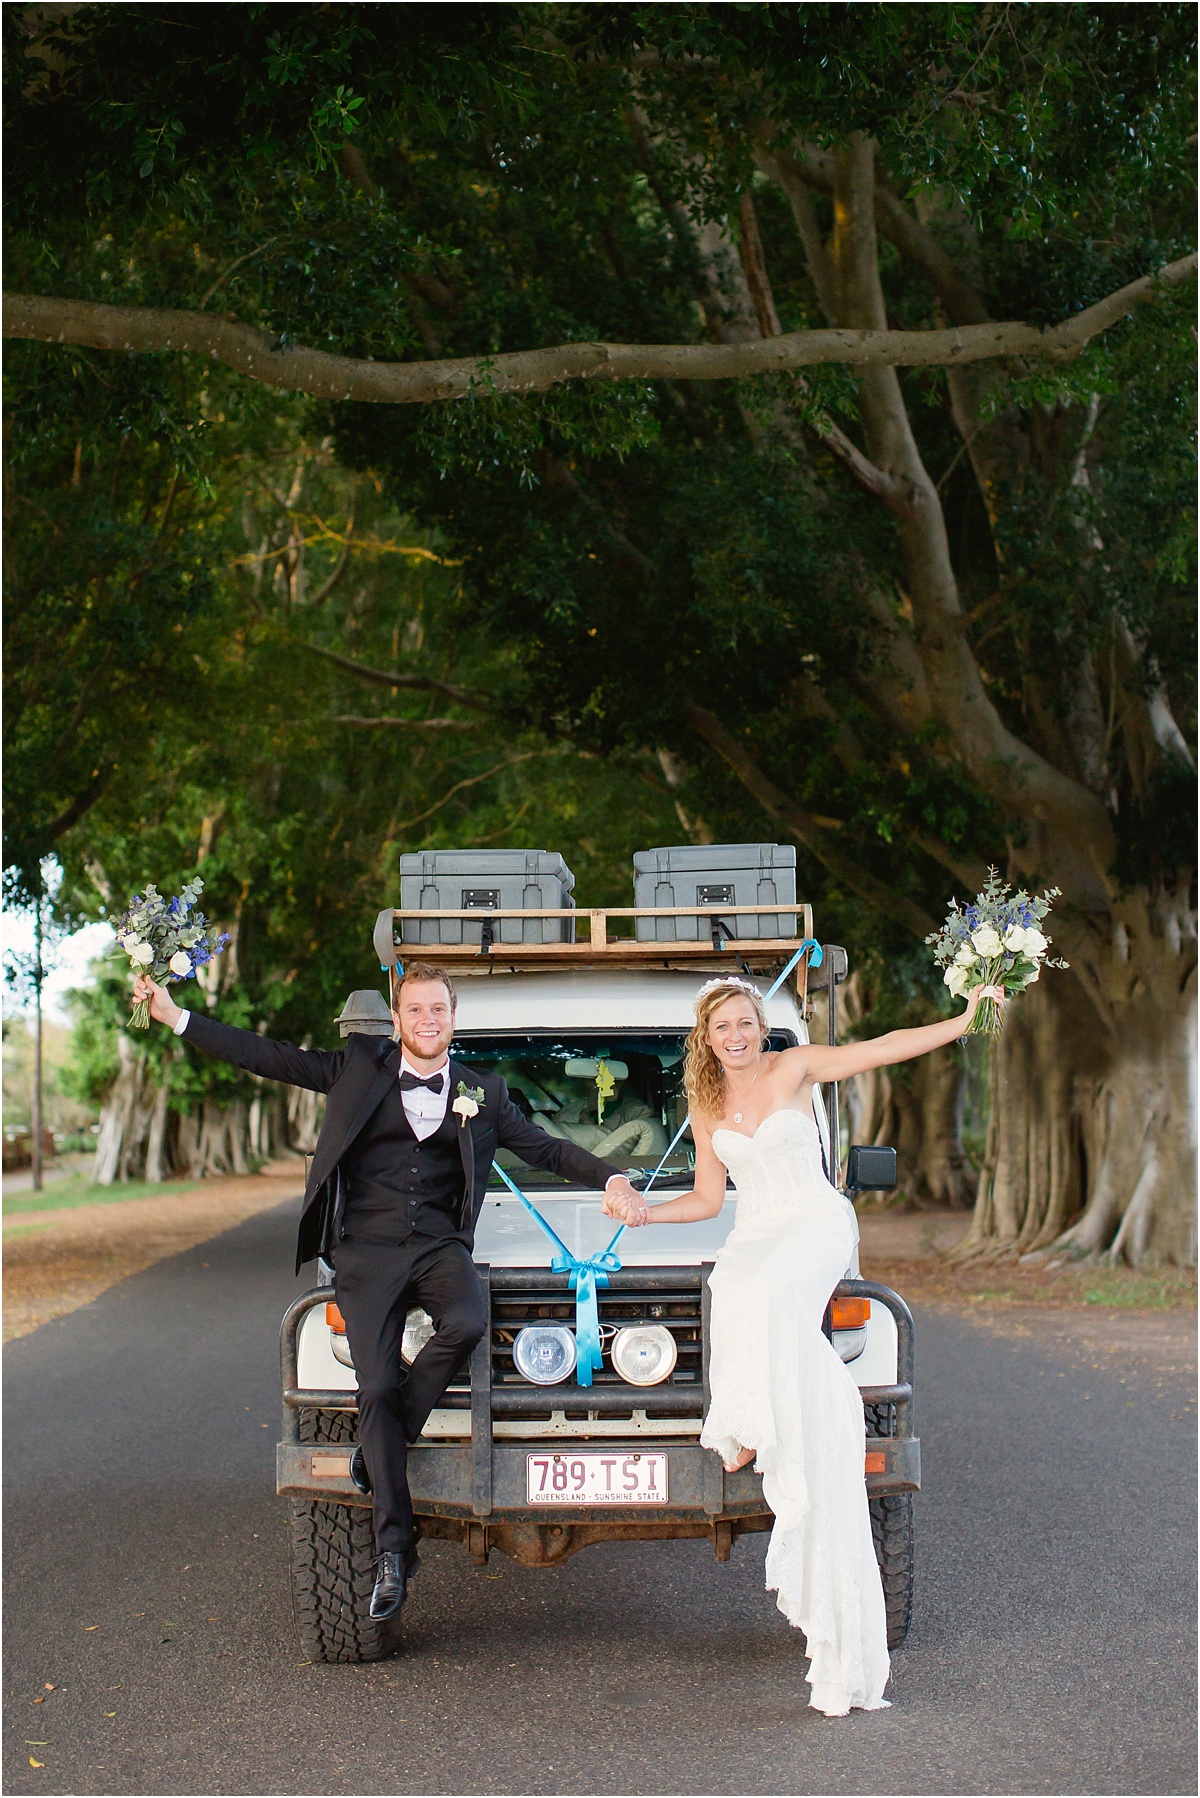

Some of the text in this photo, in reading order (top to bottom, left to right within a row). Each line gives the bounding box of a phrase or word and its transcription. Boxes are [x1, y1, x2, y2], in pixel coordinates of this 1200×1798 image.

[534, 1460, 657, 1491] 789 TSI
[535, 1493, 586, 1501] QUEENSLAND
[594, 1493, 633, 1501] SUNSHINE
[637, 1492, 660, 1500] STATE
